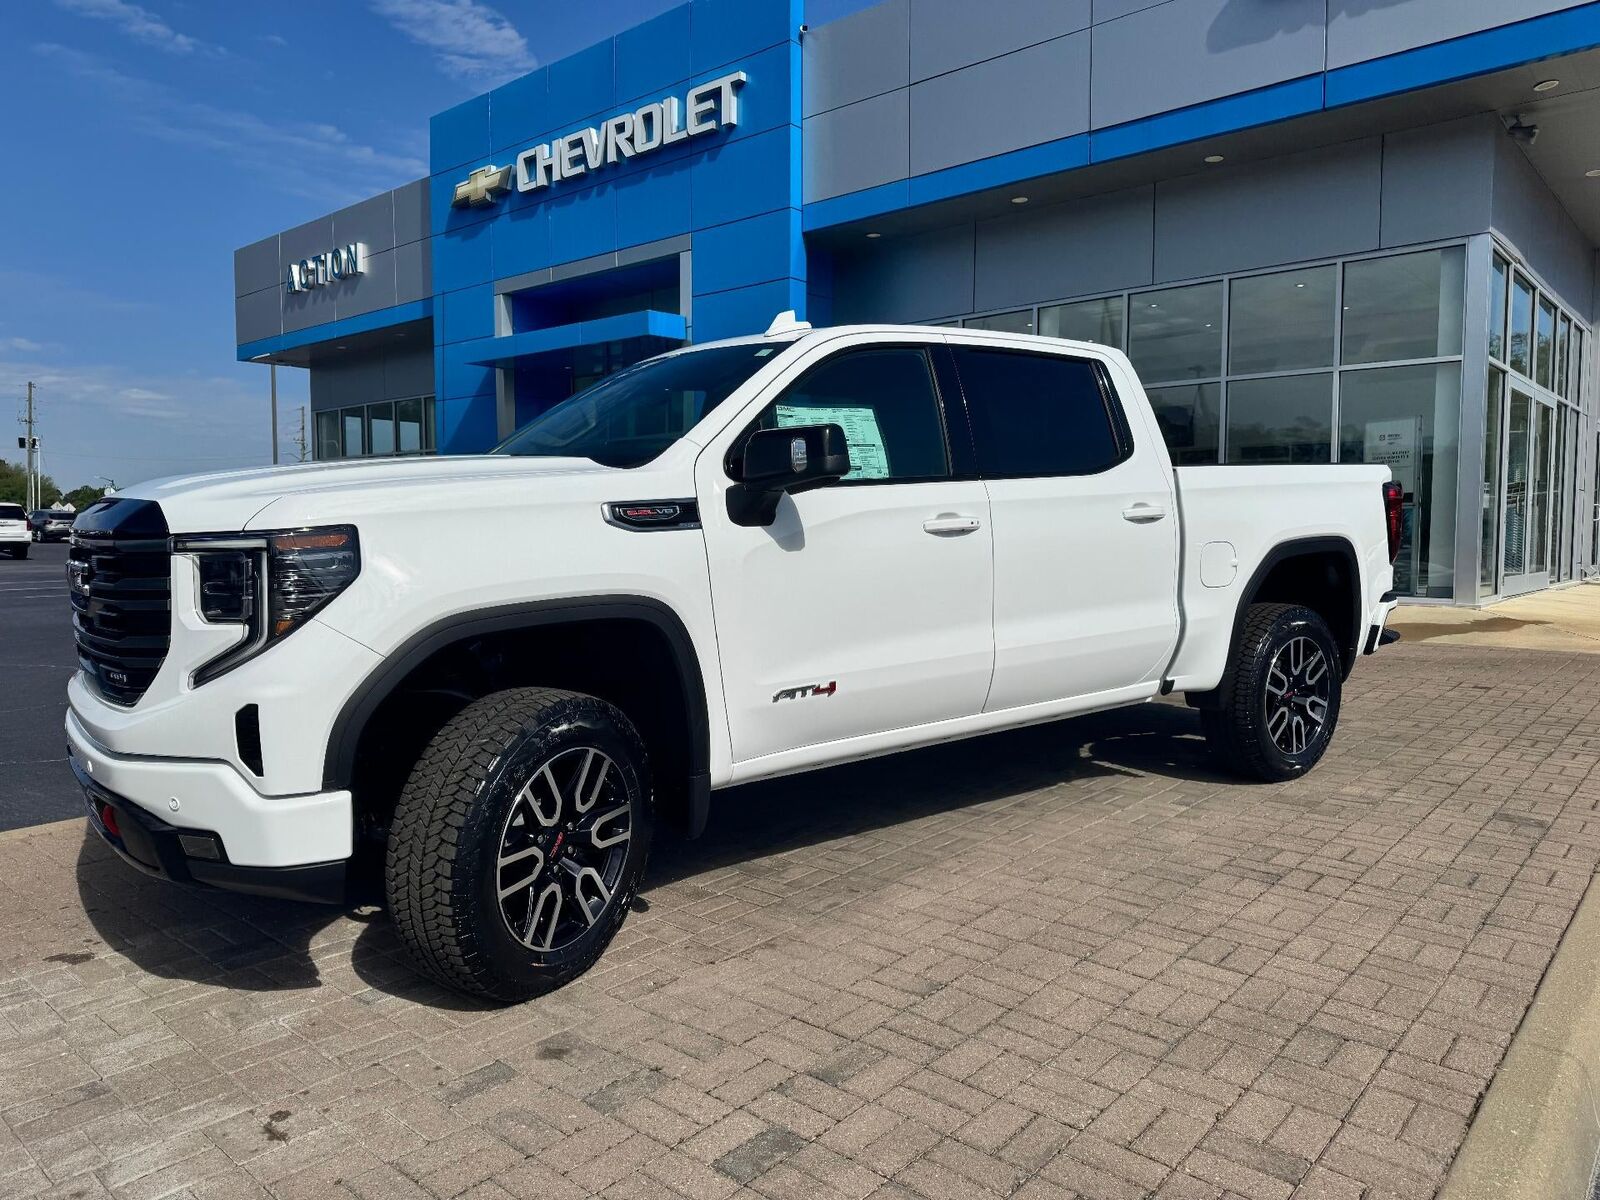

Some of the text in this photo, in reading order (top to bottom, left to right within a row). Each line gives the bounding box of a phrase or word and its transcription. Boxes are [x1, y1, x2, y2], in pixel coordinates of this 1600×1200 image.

[517, 71, 746, 193] CHEVROLET
[287, 242, 365, 294] ACTION
[772, 680, 837, 703] AT4
